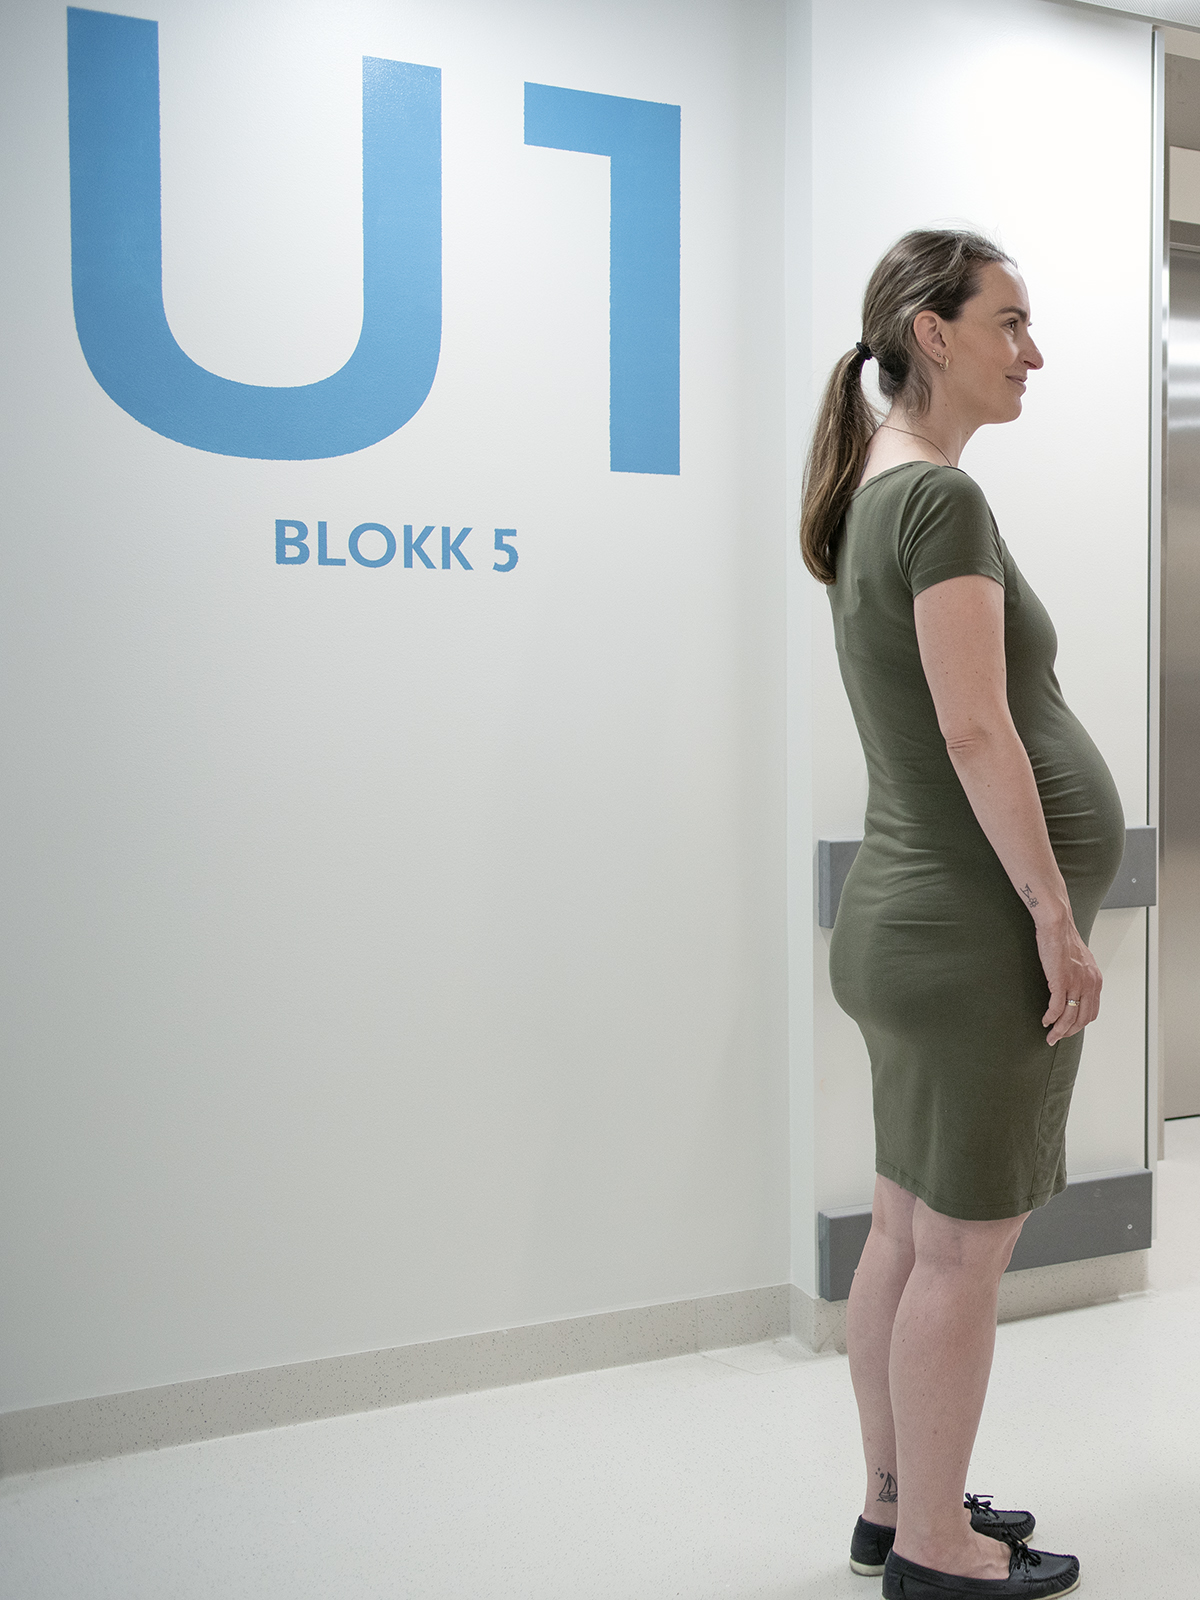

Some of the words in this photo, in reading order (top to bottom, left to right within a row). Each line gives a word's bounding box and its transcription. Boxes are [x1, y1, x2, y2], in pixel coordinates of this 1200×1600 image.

[67, 6, 681, 476] U1
[275, 519, 473, 571] BLOKK
[492, 528, 520, 573] 5
